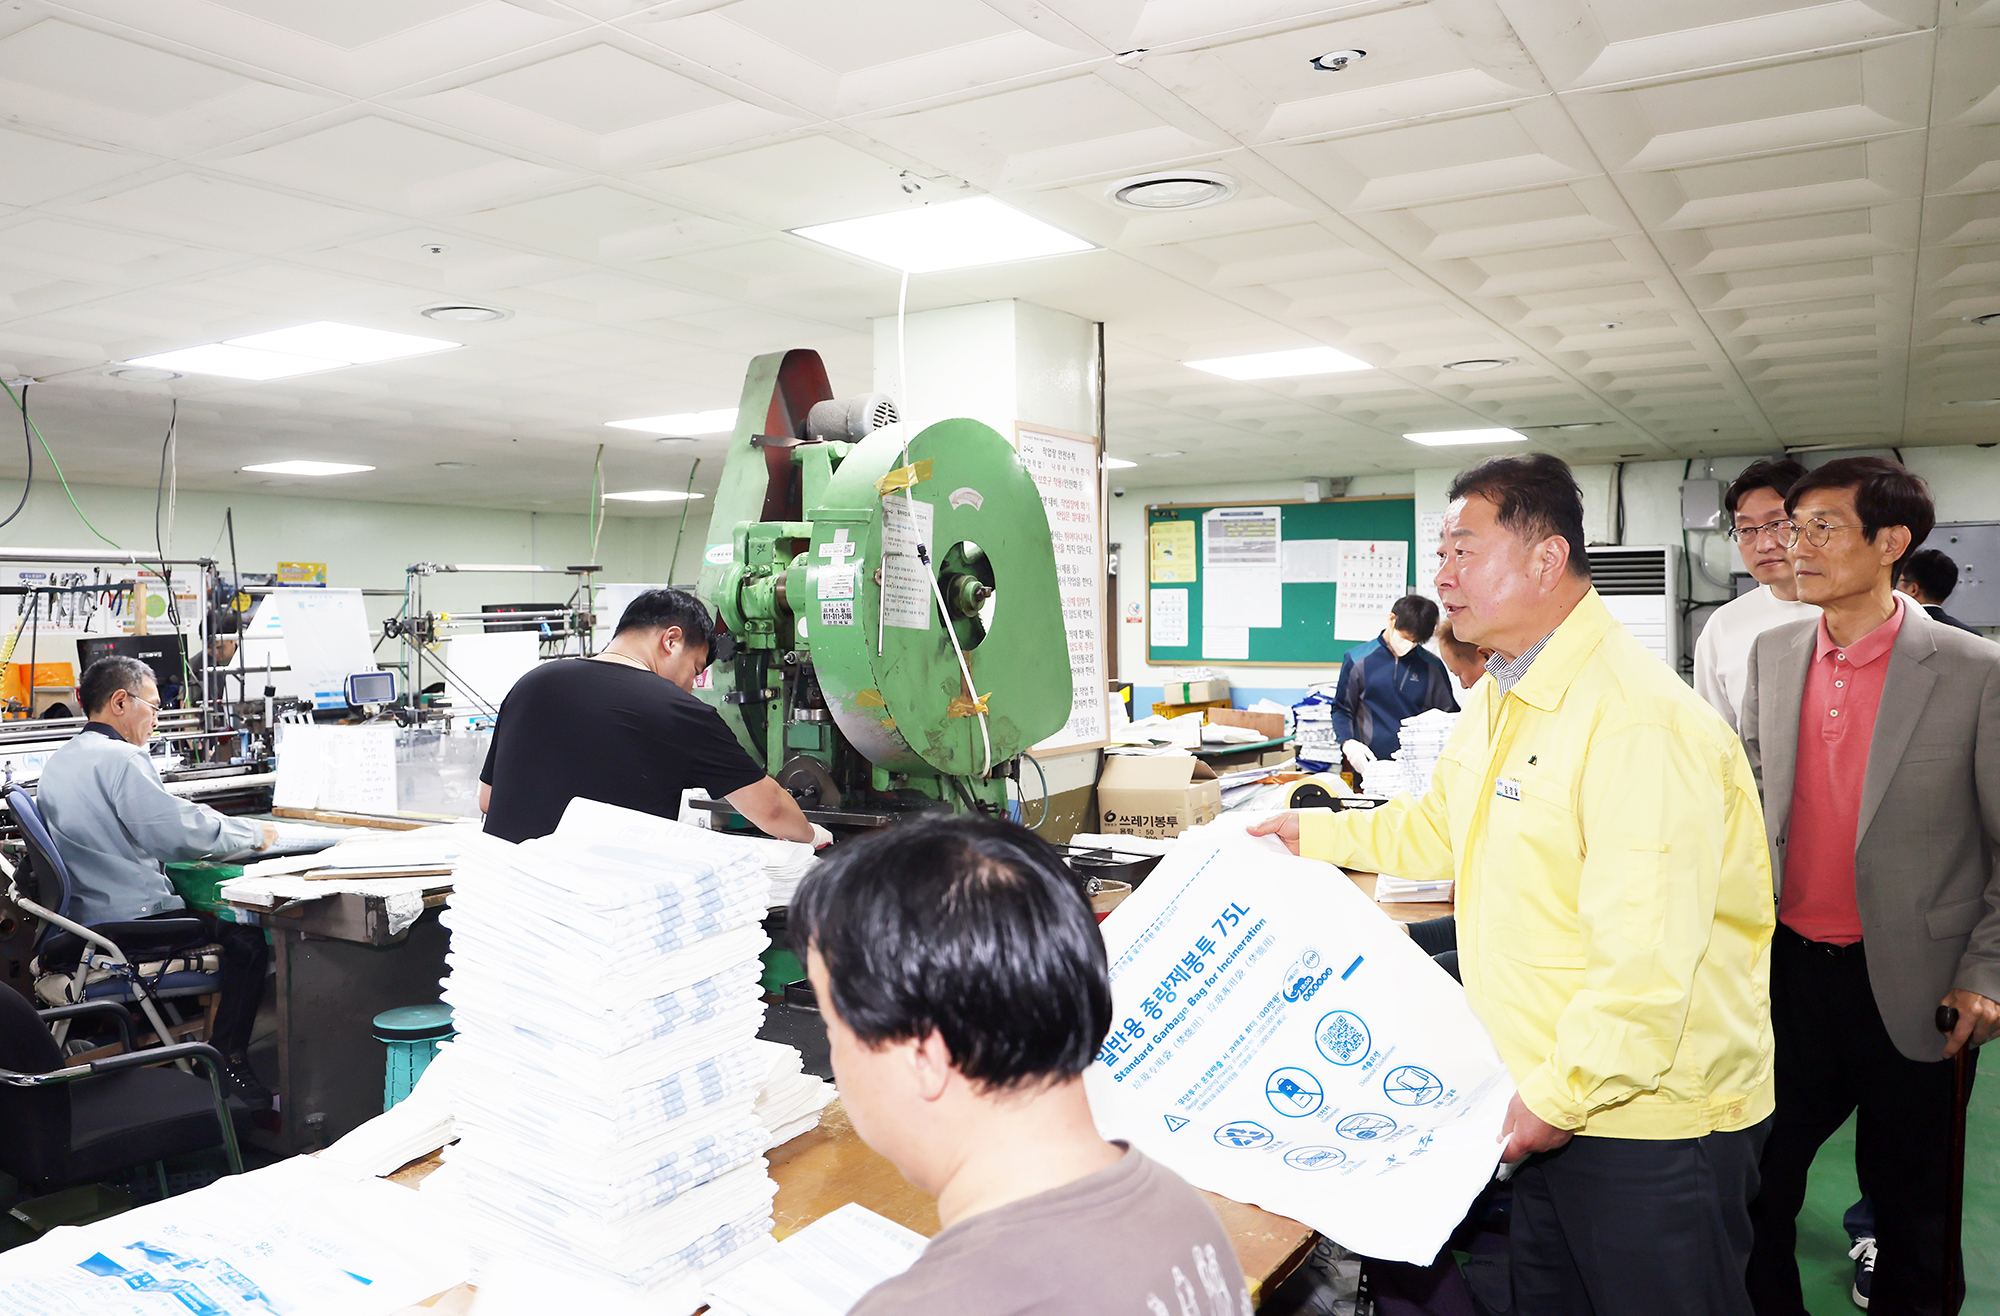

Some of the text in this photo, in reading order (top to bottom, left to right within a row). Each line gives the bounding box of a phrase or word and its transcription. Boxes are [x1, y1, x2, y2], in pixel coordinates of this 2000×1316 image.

[1042, 446, 1077, 462] 작업장 안전수칙
[1038, 475, 1052, 486] 보호구
[1061, 498, 1080, 510] 작업장에
[1056, 511, 1071, 522] 반입은
[1065, 531, 1093, 543] 뛰어다니거나
[1066, 544, 1076, 555] 치지
[1067, 576, 1081, 588] 작업을
[1082, 577, 1094, 588] 한다.
[1077, 597, 1091, 608] 일부가
[1068, 609, 1082, 620] 않도록
[1083, 609, 1094, 620] 한다.
[1085, 629, 1095, 640] 때는
[1069, 641, 1094, 652] 않도록 주의
[1071, 653, 1094, 665] 안전통로를
[1085, 665, 1097, 676] 한다.
[1080, 686, 1089, 697] 작업
[1074, 697, 1100, 710] 철저히 한다.
[1080, 716, 1090, 727] 마실
[1076, 725, 1101, 738] 있도록 한다.
[1119, 815, 1179, 828] 쓰레기봉투
[1145, 828, 1155, 836] 50
[1094, 902, 1250, 1067] 일반용 종량제봉투 75L
[1114, 918, 1267, 1082] Standard Garbage Bag for Incineration
[1229, 1034, 1246, 1053] 과태료
[1245, 1020, 1258, 1034] 최대
[1232, 1052, 1243, 1064] Fine
[1273, 1001, 1286, 1016] KRW
[1359, 1046, 1396, 1087] Disposal Guidelines
[1361, 1051, 1380, 1071] 배출요령
[1316, 1105, 1330, 1121] 건전지
